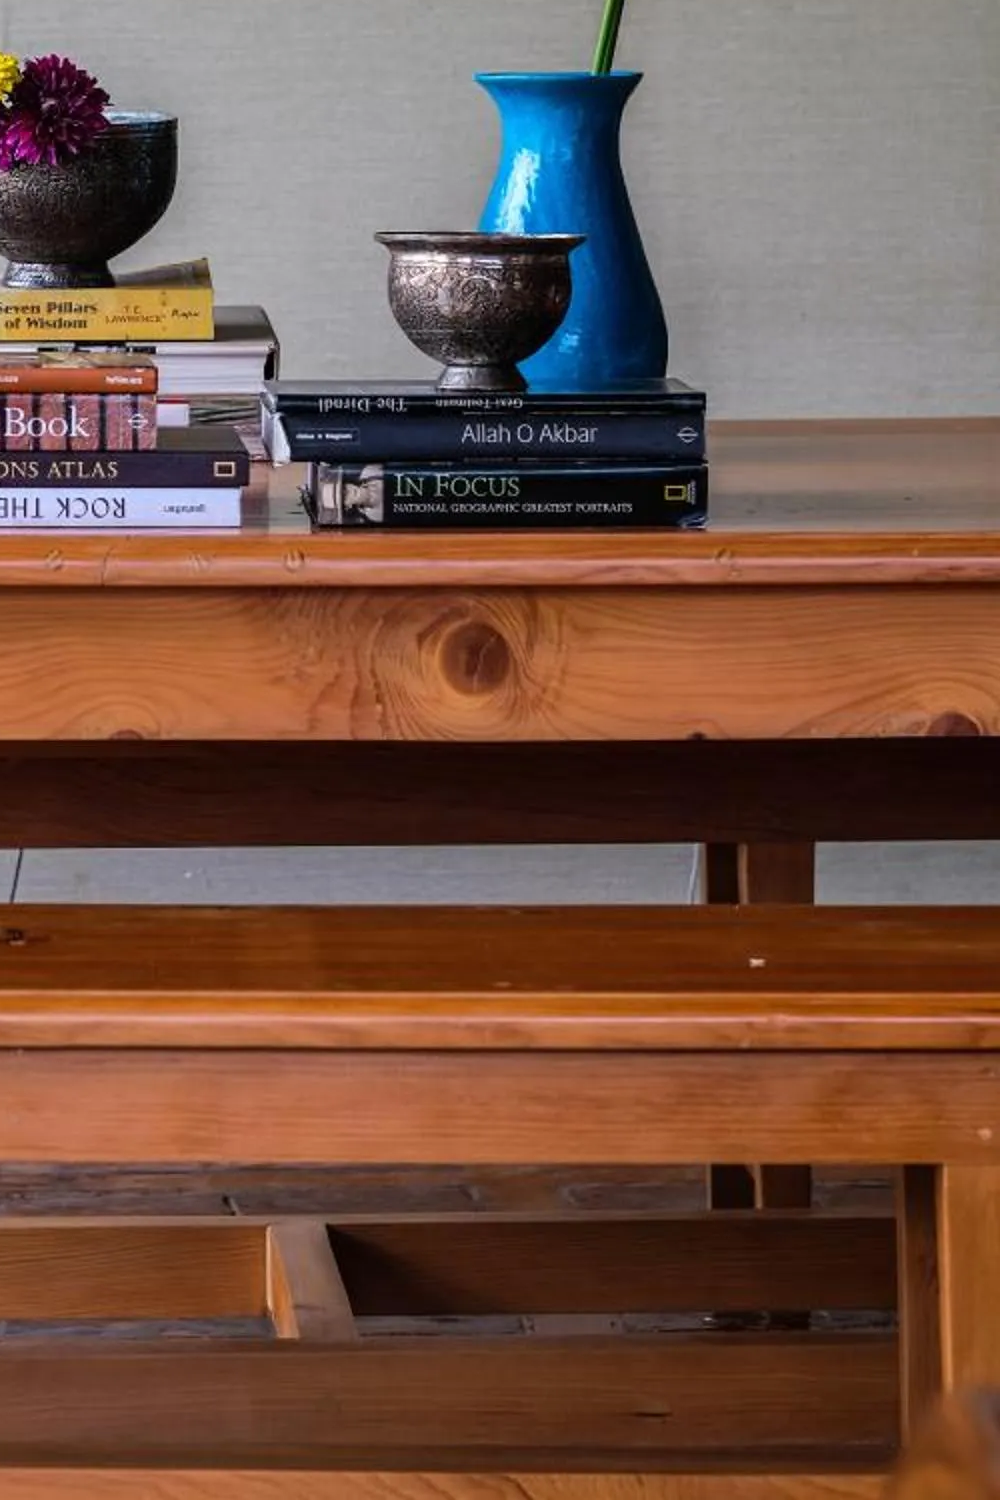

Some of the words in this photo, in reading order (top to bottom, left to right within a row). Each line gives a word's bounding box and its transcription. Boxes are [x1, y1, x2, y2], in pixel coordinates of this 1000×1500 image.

[46, 301, 98, 315] Pillars
[4, 316, 21, 330] of
[27, 316, 88, 330] Wisdom
[318, 397, 370, 412] Dirndl
[376, 397, 407, 412] The
[3, 405, 91, 438] Book
[461, 422, 512, 444] Allah
[516, 423, 534, 444] O
[539, 422, 599, 444] Akbar
[46, 461, 119, 479] ATLAS
[56, 497, 126, 519] ROCK
[393, 502, 449, 513] NATIONAL
[450, 502, 521, 513] GEOGRAPHIC
[521, 502, 573, 513] GREATEST
[574, 502, 634, 513] PORTRAITS
